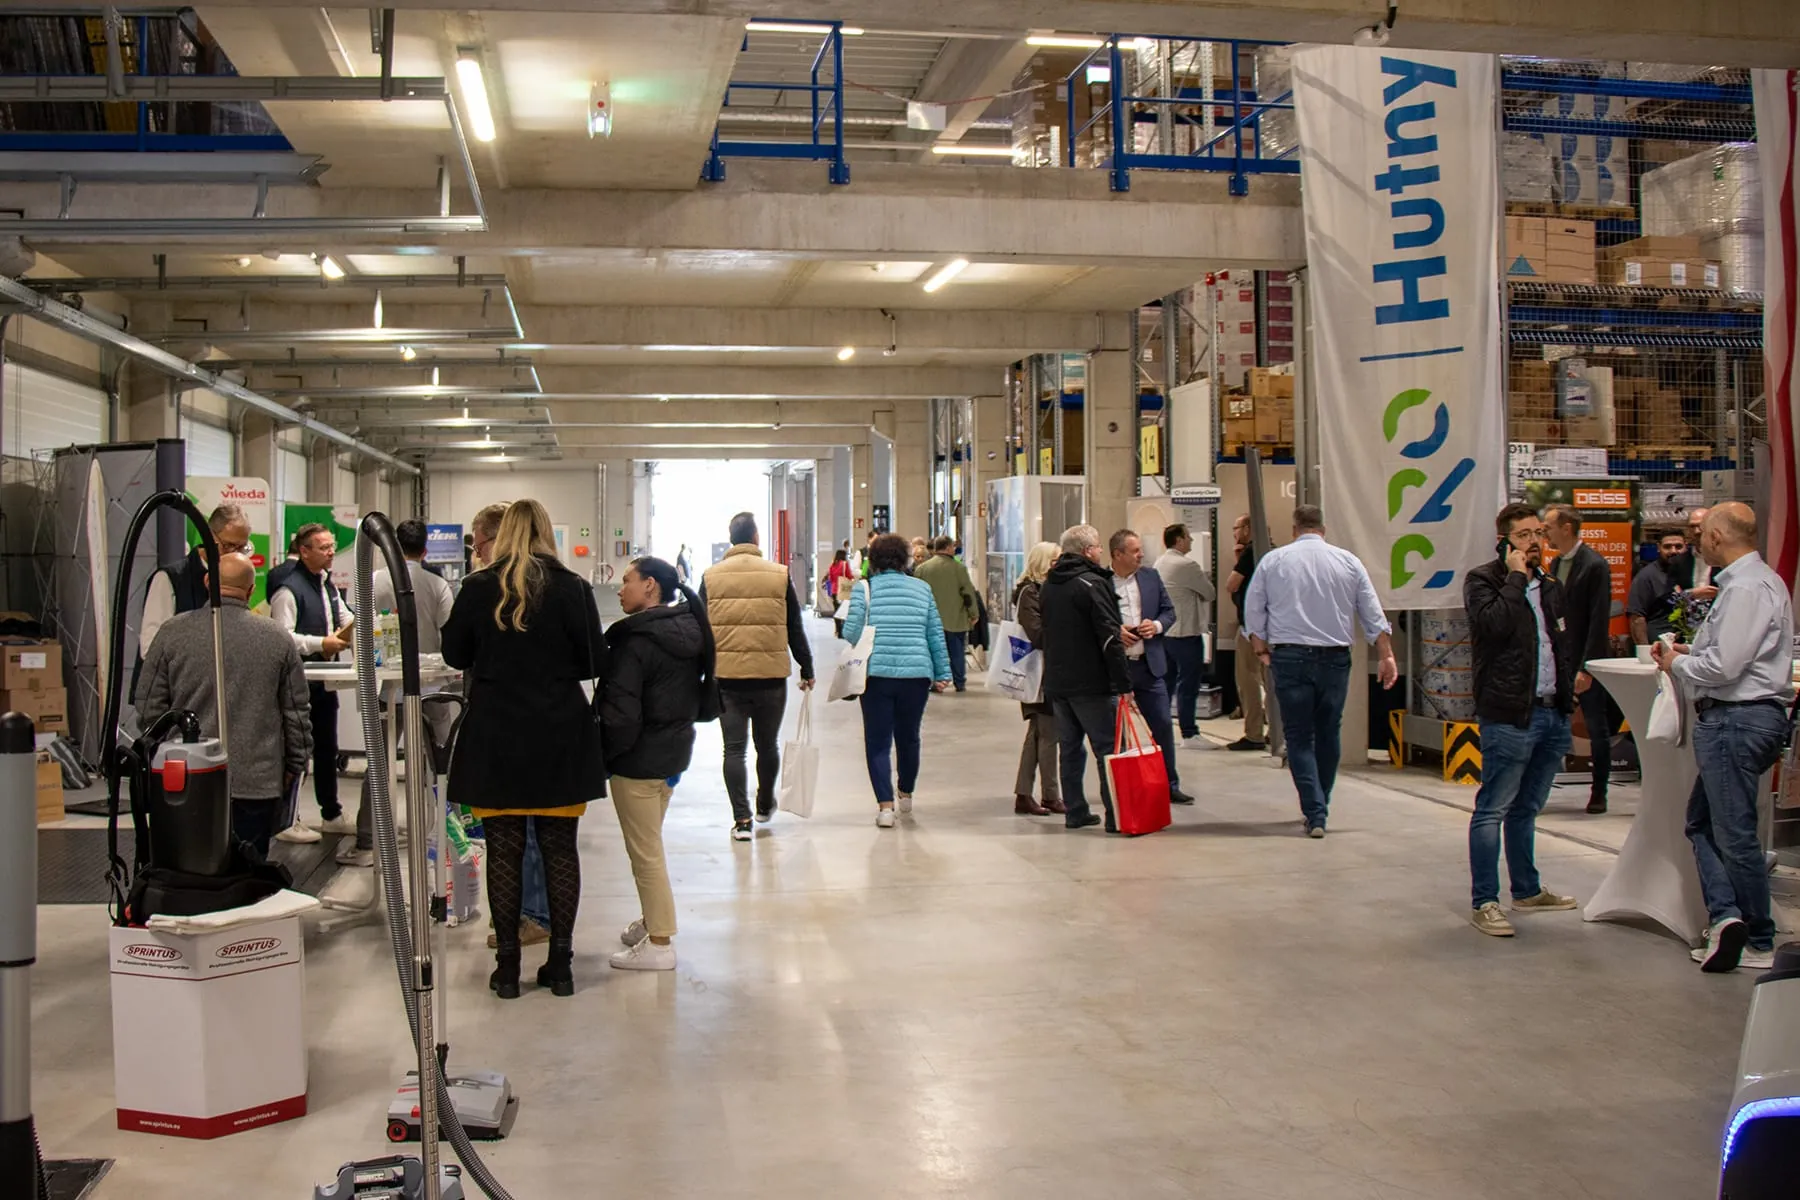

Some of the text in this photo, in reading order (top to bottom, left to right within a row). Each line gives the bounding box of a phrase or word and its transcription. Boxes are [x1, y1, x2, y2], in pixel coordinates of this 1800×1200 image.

[1372, 55, 1458, 326] Hutny
[220, 484, 266, 499] vileda
[1609, 543, 1627, 552] DER
